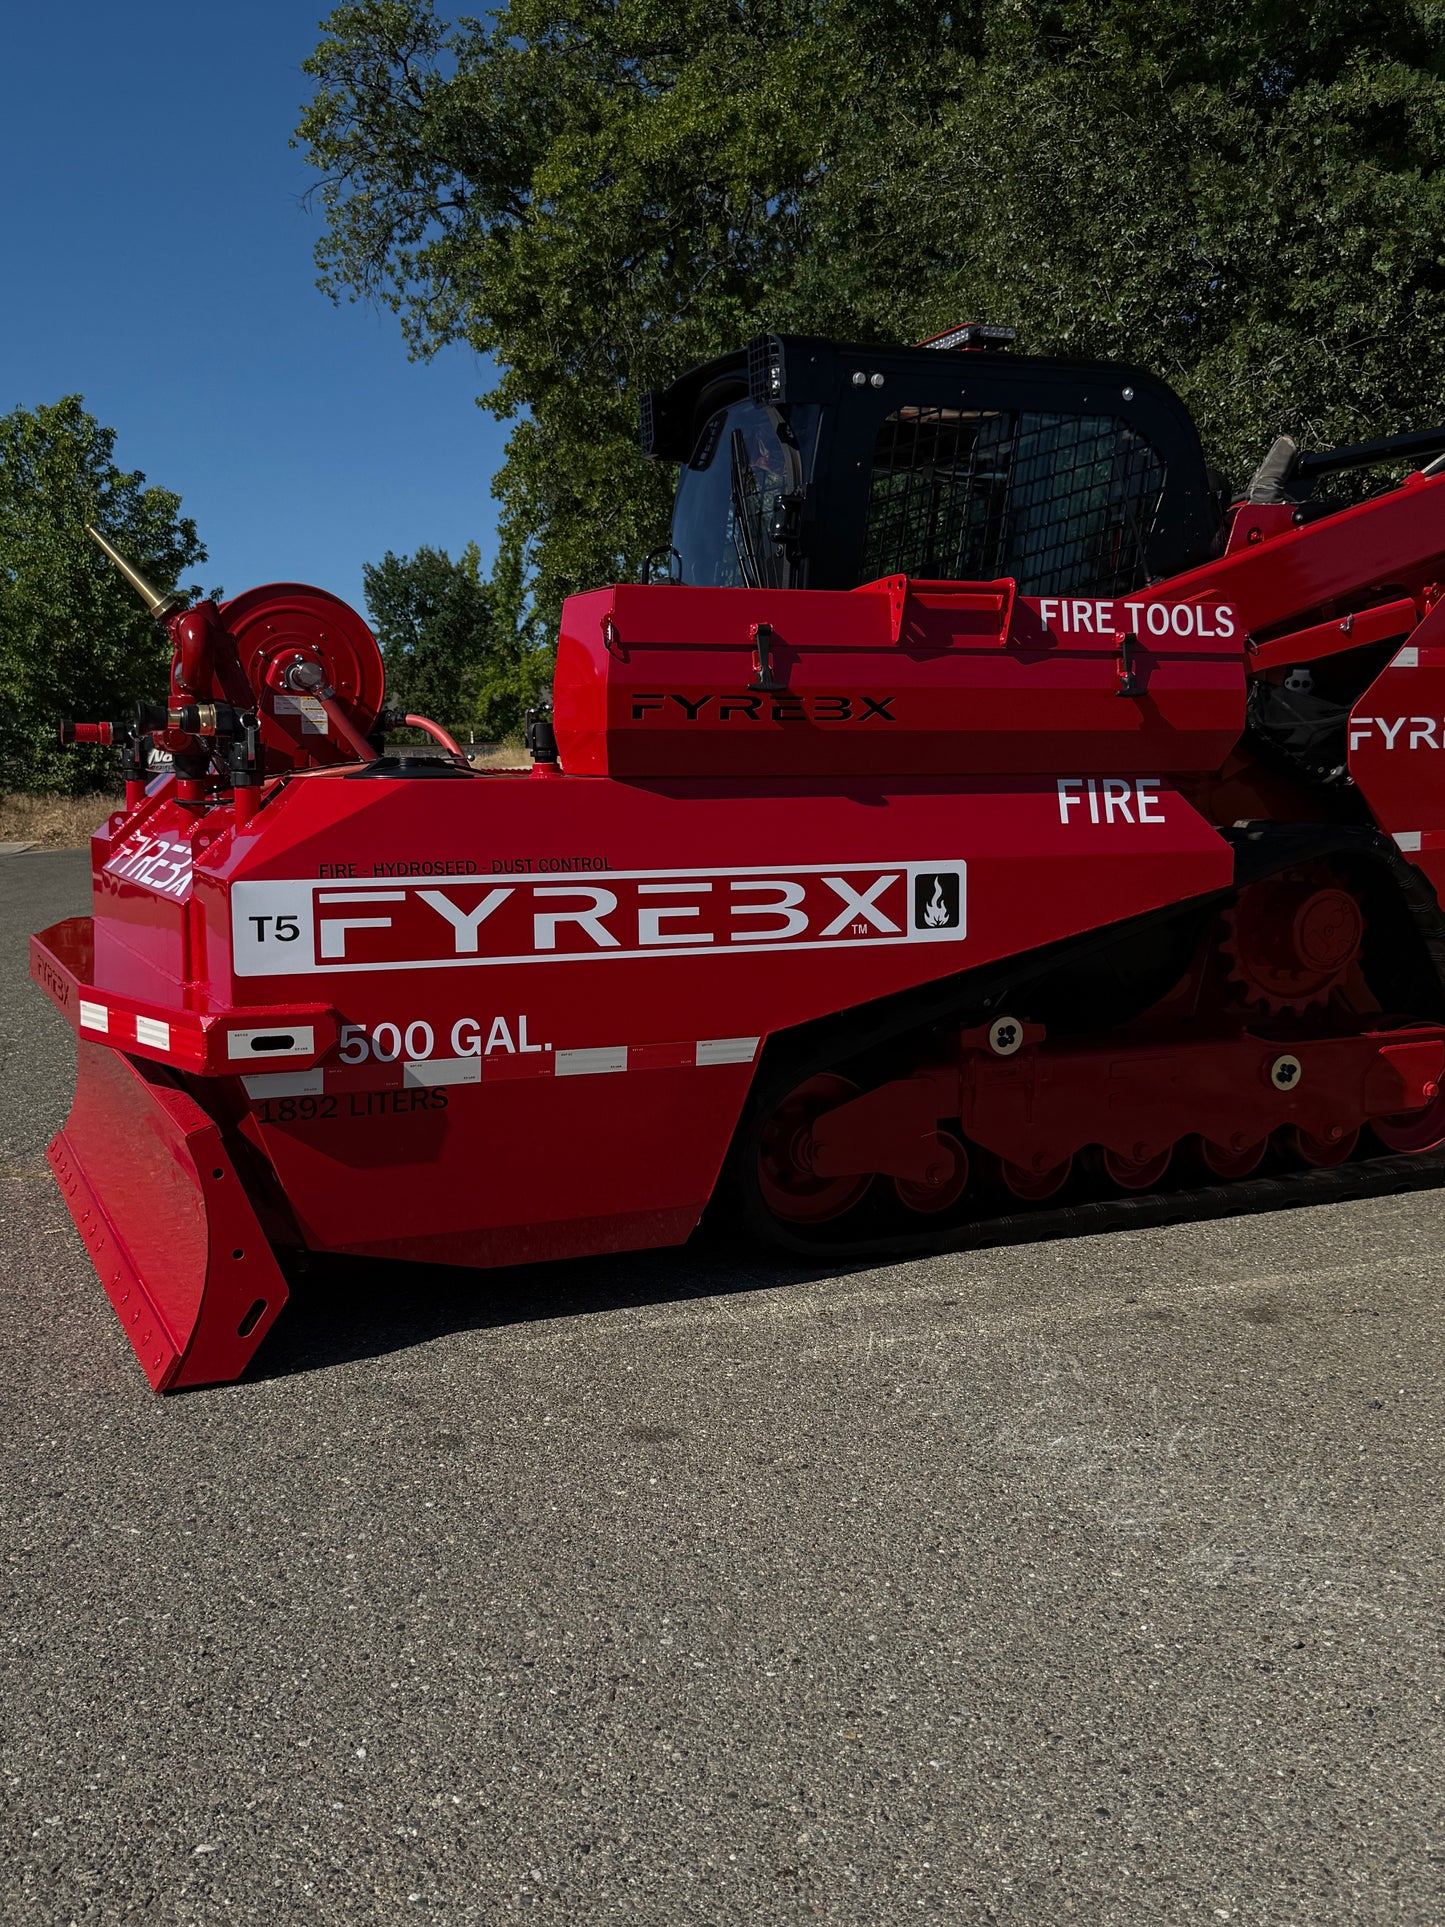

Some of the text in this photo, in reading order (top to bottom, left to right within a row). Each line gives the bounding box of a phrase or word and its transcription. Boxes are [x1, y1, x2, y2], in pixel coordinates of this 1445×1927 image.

[1040, 599, 1235, 638] FIRE TOOLS
[1350, 717, 1445, 750] FYR
[1057, 778, 1165, 824] FIRE
[319, 863, 358, 879] FIRE
[373, 860, 477, 878] HYDROSEED
[491, 859, 533, 874] DUST
[538, 856, 613, 872] CONTROL
[248, 914, 300, 943] T5
[338, 1014, 553, 1065] 500 GAL.
[258, 1086, 449, 1124] 1892 LITERS
